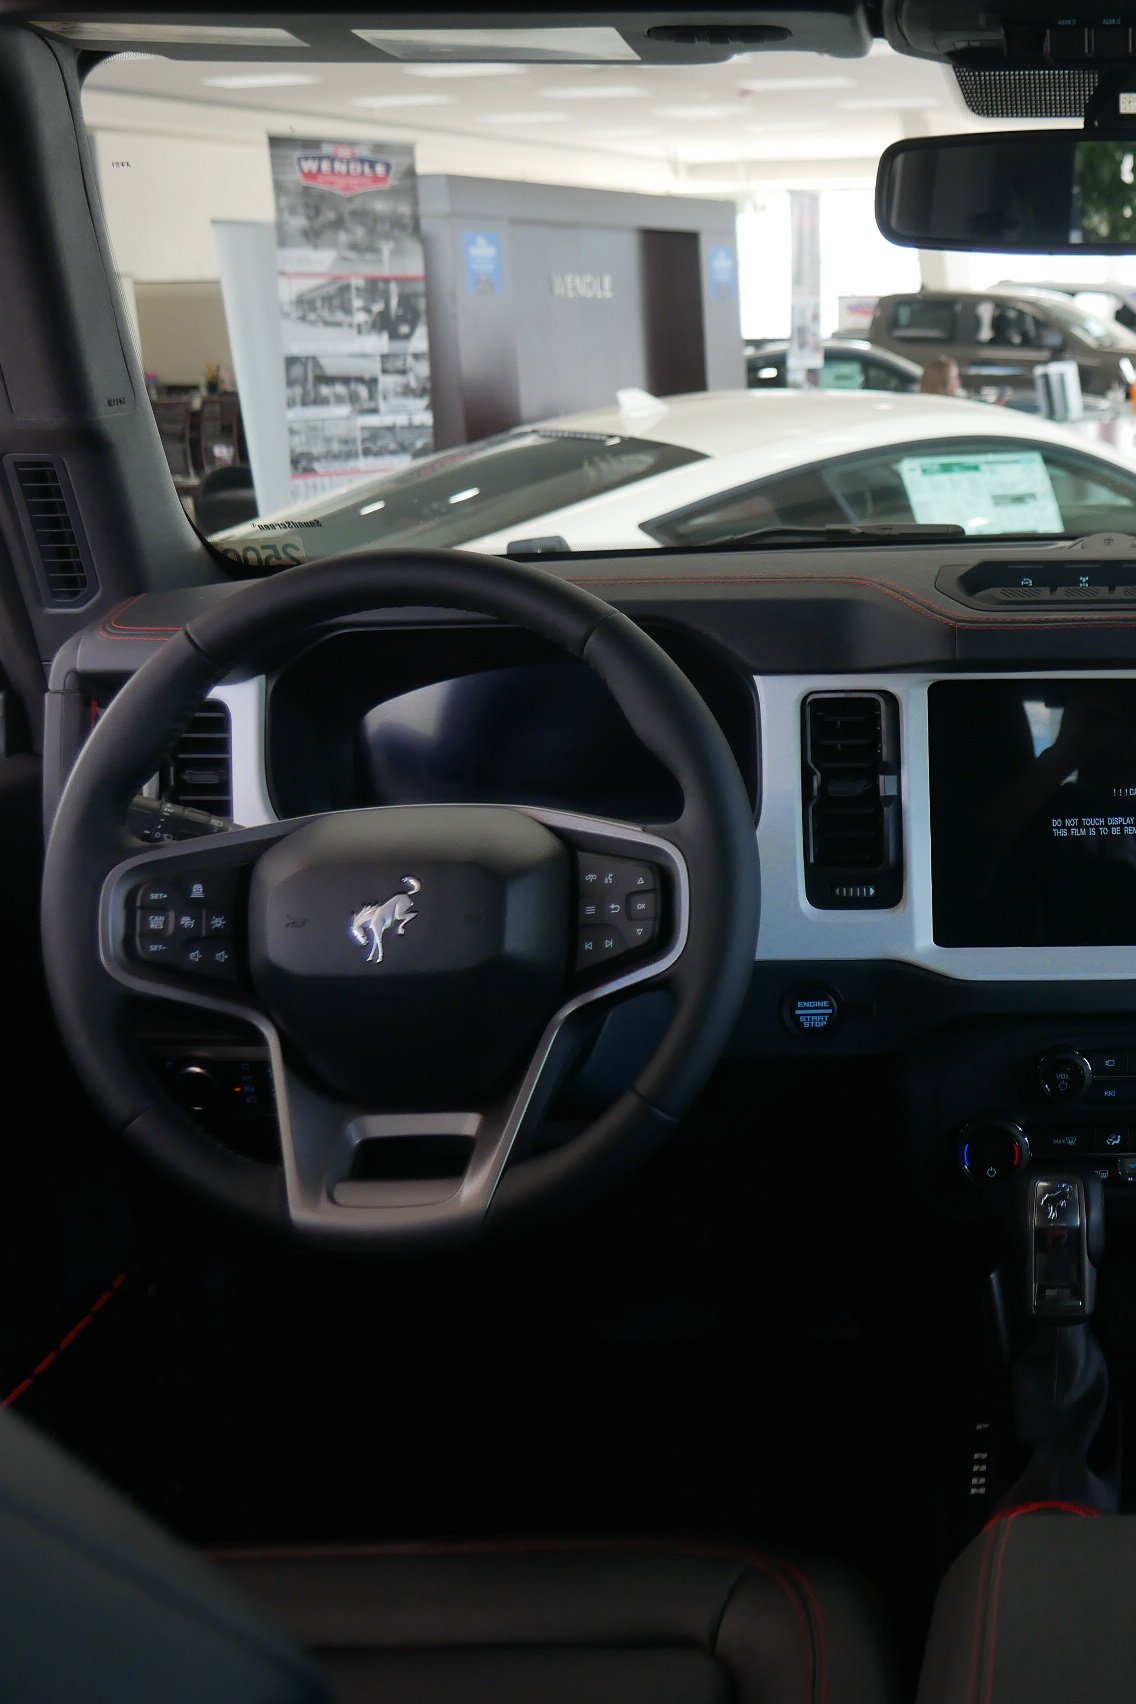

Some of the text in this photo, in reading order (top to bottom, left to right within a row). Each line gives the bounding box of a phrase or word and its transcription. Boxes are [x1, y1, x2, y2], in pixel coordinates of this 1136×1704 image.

[300, 157, 387, 178] WENDLE
[551, 273, 613, 299] WENDLE
[1082, 818, 1104, 826] TOUCH
[1108, 817, 1134, 825] DISPLAY
[1071, 828, 1085, 836] FILM
